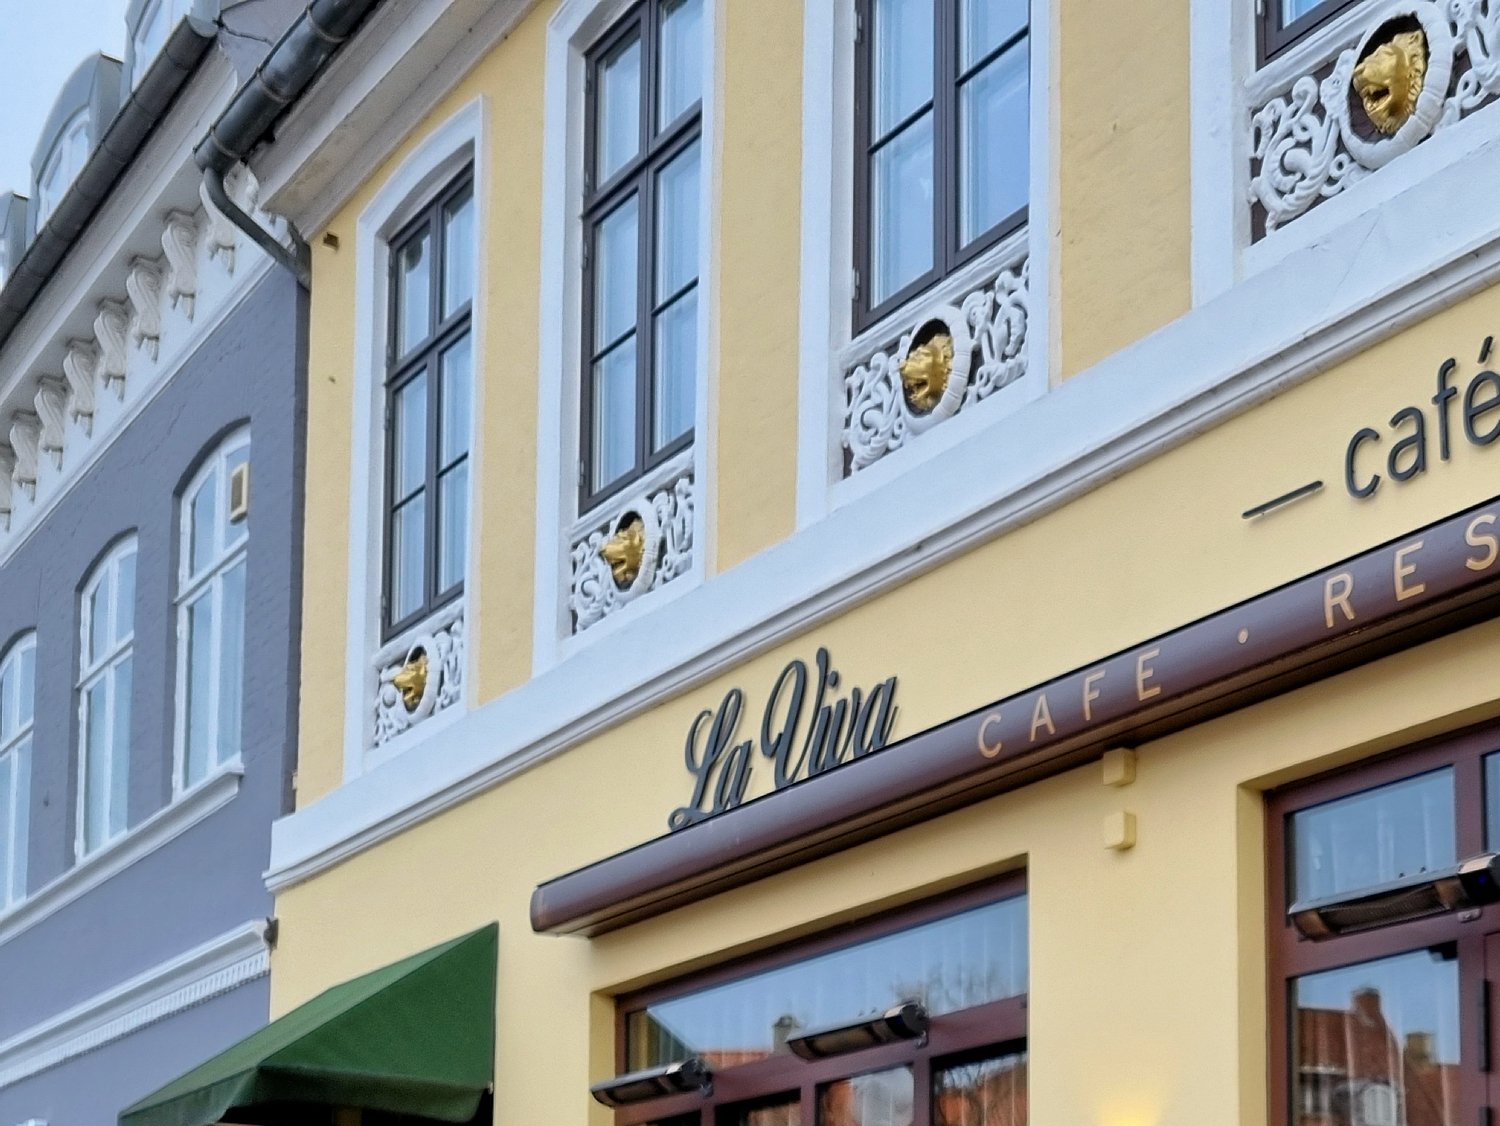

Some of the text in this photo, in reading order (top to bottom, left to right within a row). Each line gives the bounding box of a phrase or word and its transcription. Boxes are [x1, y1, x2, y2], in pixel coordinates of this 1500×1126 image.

[667, 646, 900, 832] La Viva
[977, 648, 1162, 759] CAFE
